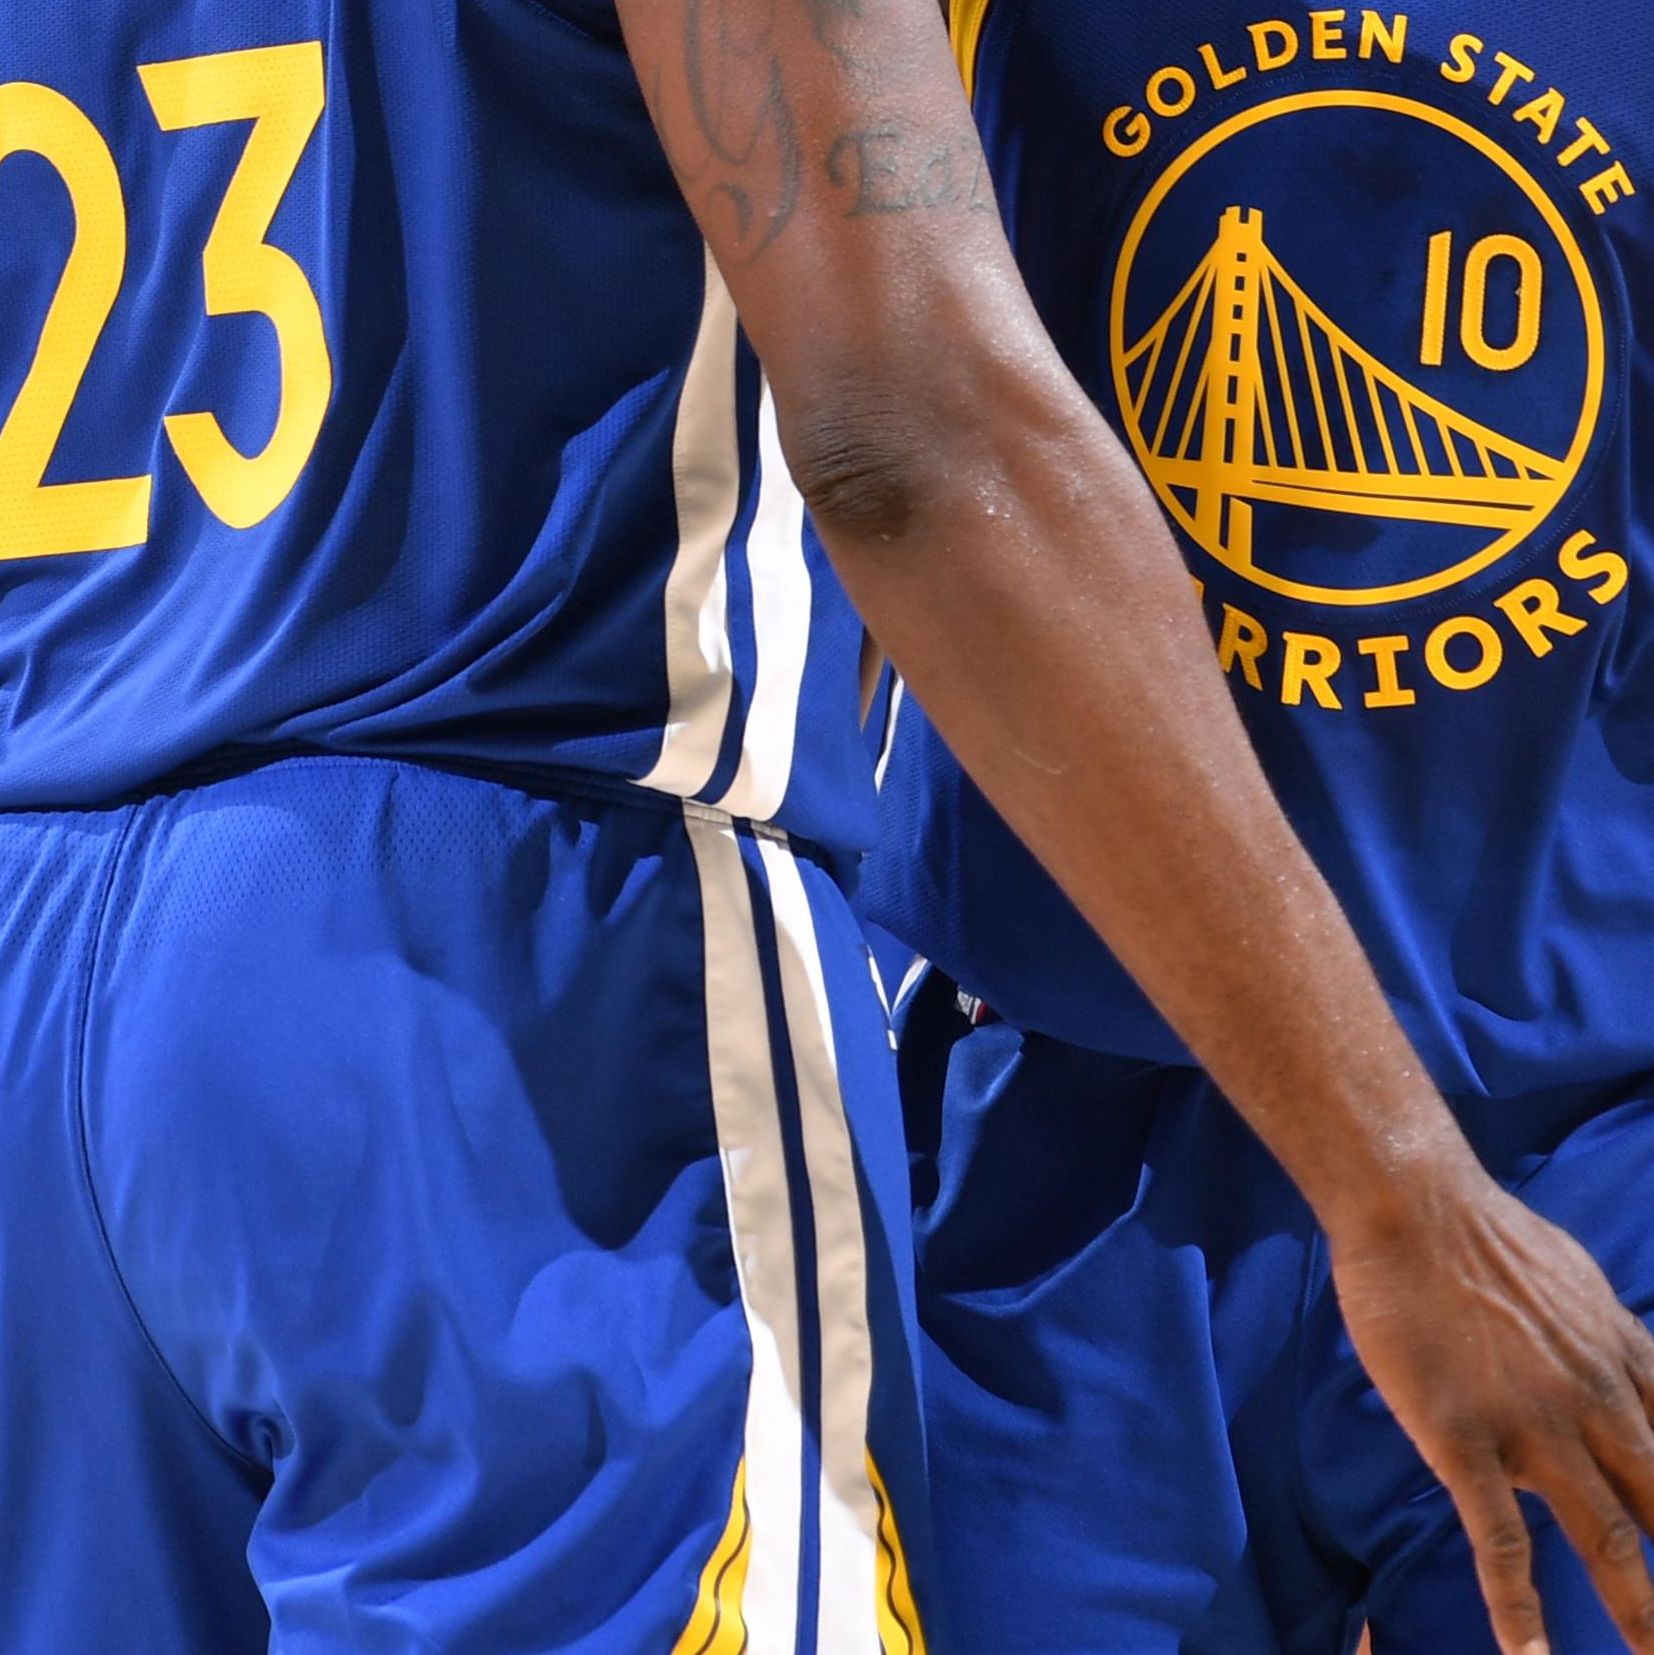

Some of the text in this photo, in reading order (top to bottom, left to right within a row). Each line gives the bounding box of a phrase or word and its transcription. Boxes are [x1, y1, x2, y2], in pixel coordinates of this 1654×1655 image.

[1102, 9, 1636, 216] GOLDEN STATE
[1420, 229, 1543, 372] 10
[1193, 528, 1629, 711] RRIORS
